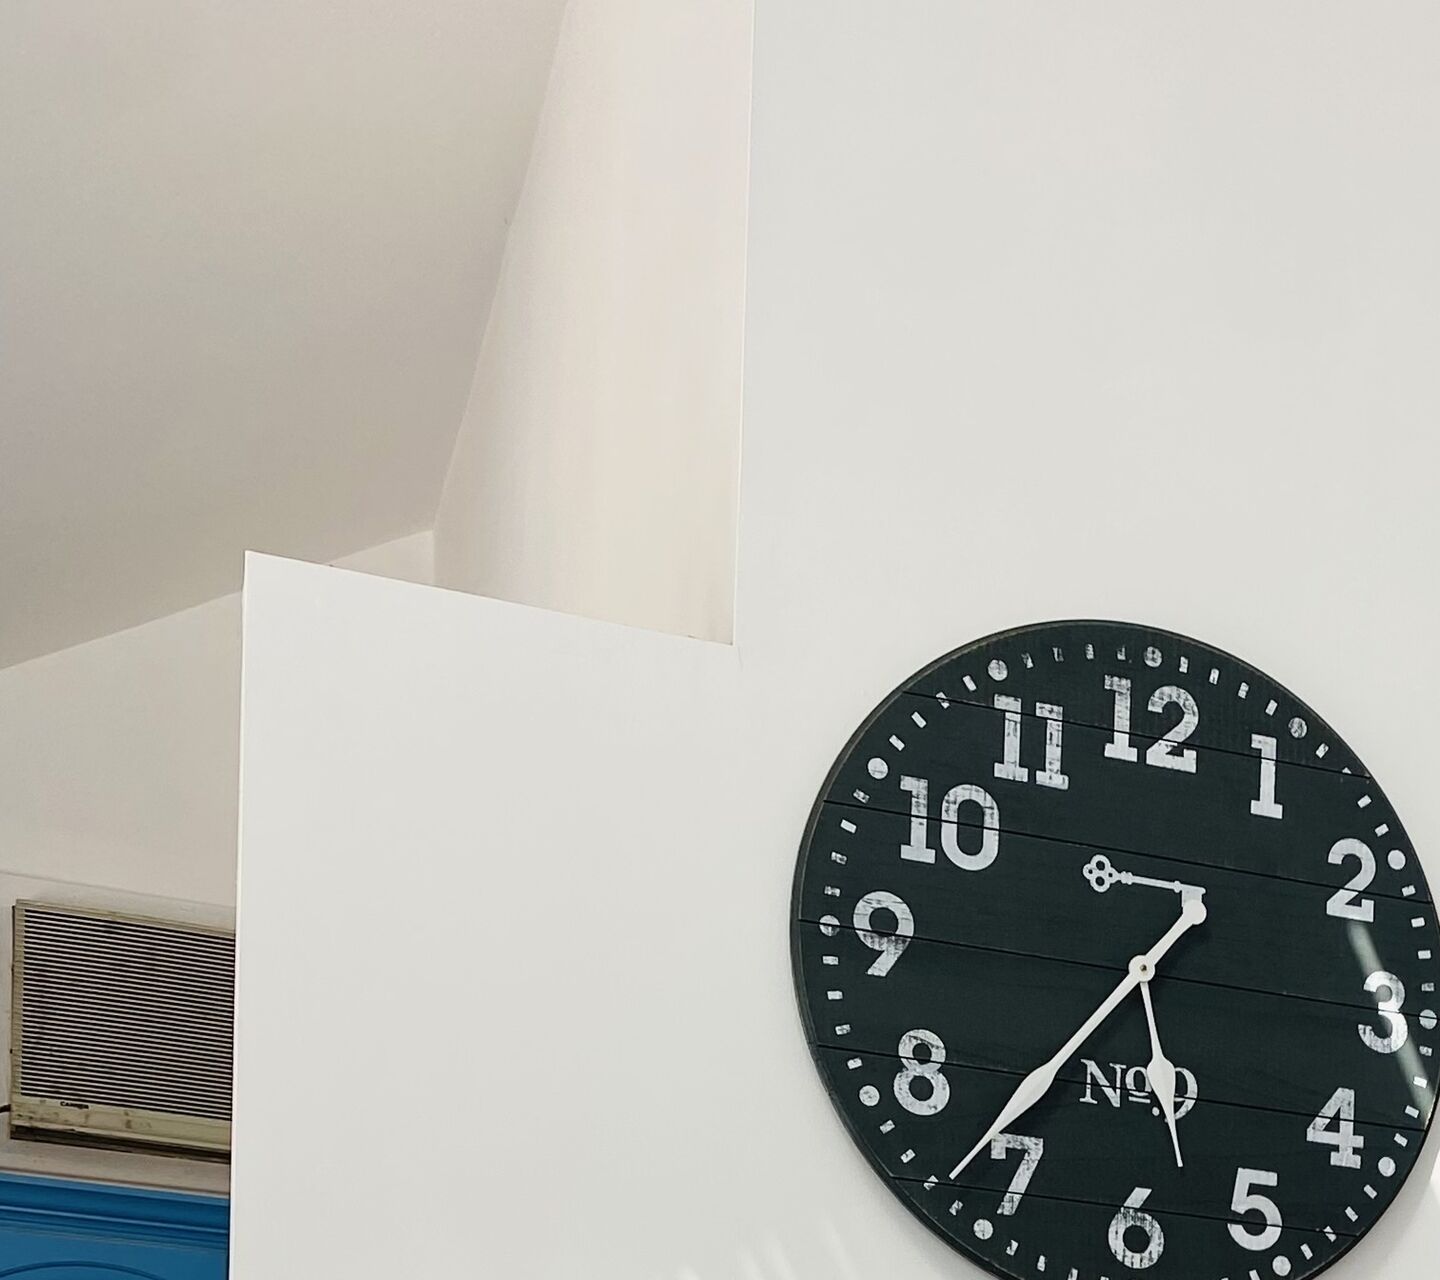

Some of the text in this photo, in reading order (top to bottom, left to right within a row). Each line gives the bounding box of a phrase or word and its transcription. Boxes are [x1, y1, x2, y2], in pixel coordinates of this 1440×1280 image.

[993, 693, 1069, 790] 11
[1103, 674, 1199, 774] 12
[1249, 733, 1284, 820] 1
[899, 775, 1001, 871] 10
[1325, 837, 1377, 923] 2
[852, 890, 915, 977] 9
[1357, 970, 1409, 1054] 3
[892, 1028, 951, 1116] 8
[1305, 1086, 1365, 1170] 4
[990, 1133, 1044, 1216] 7
[1227, 1166, 1283, 1251] 5
[1107, 1186, 1165, 1270] 6
